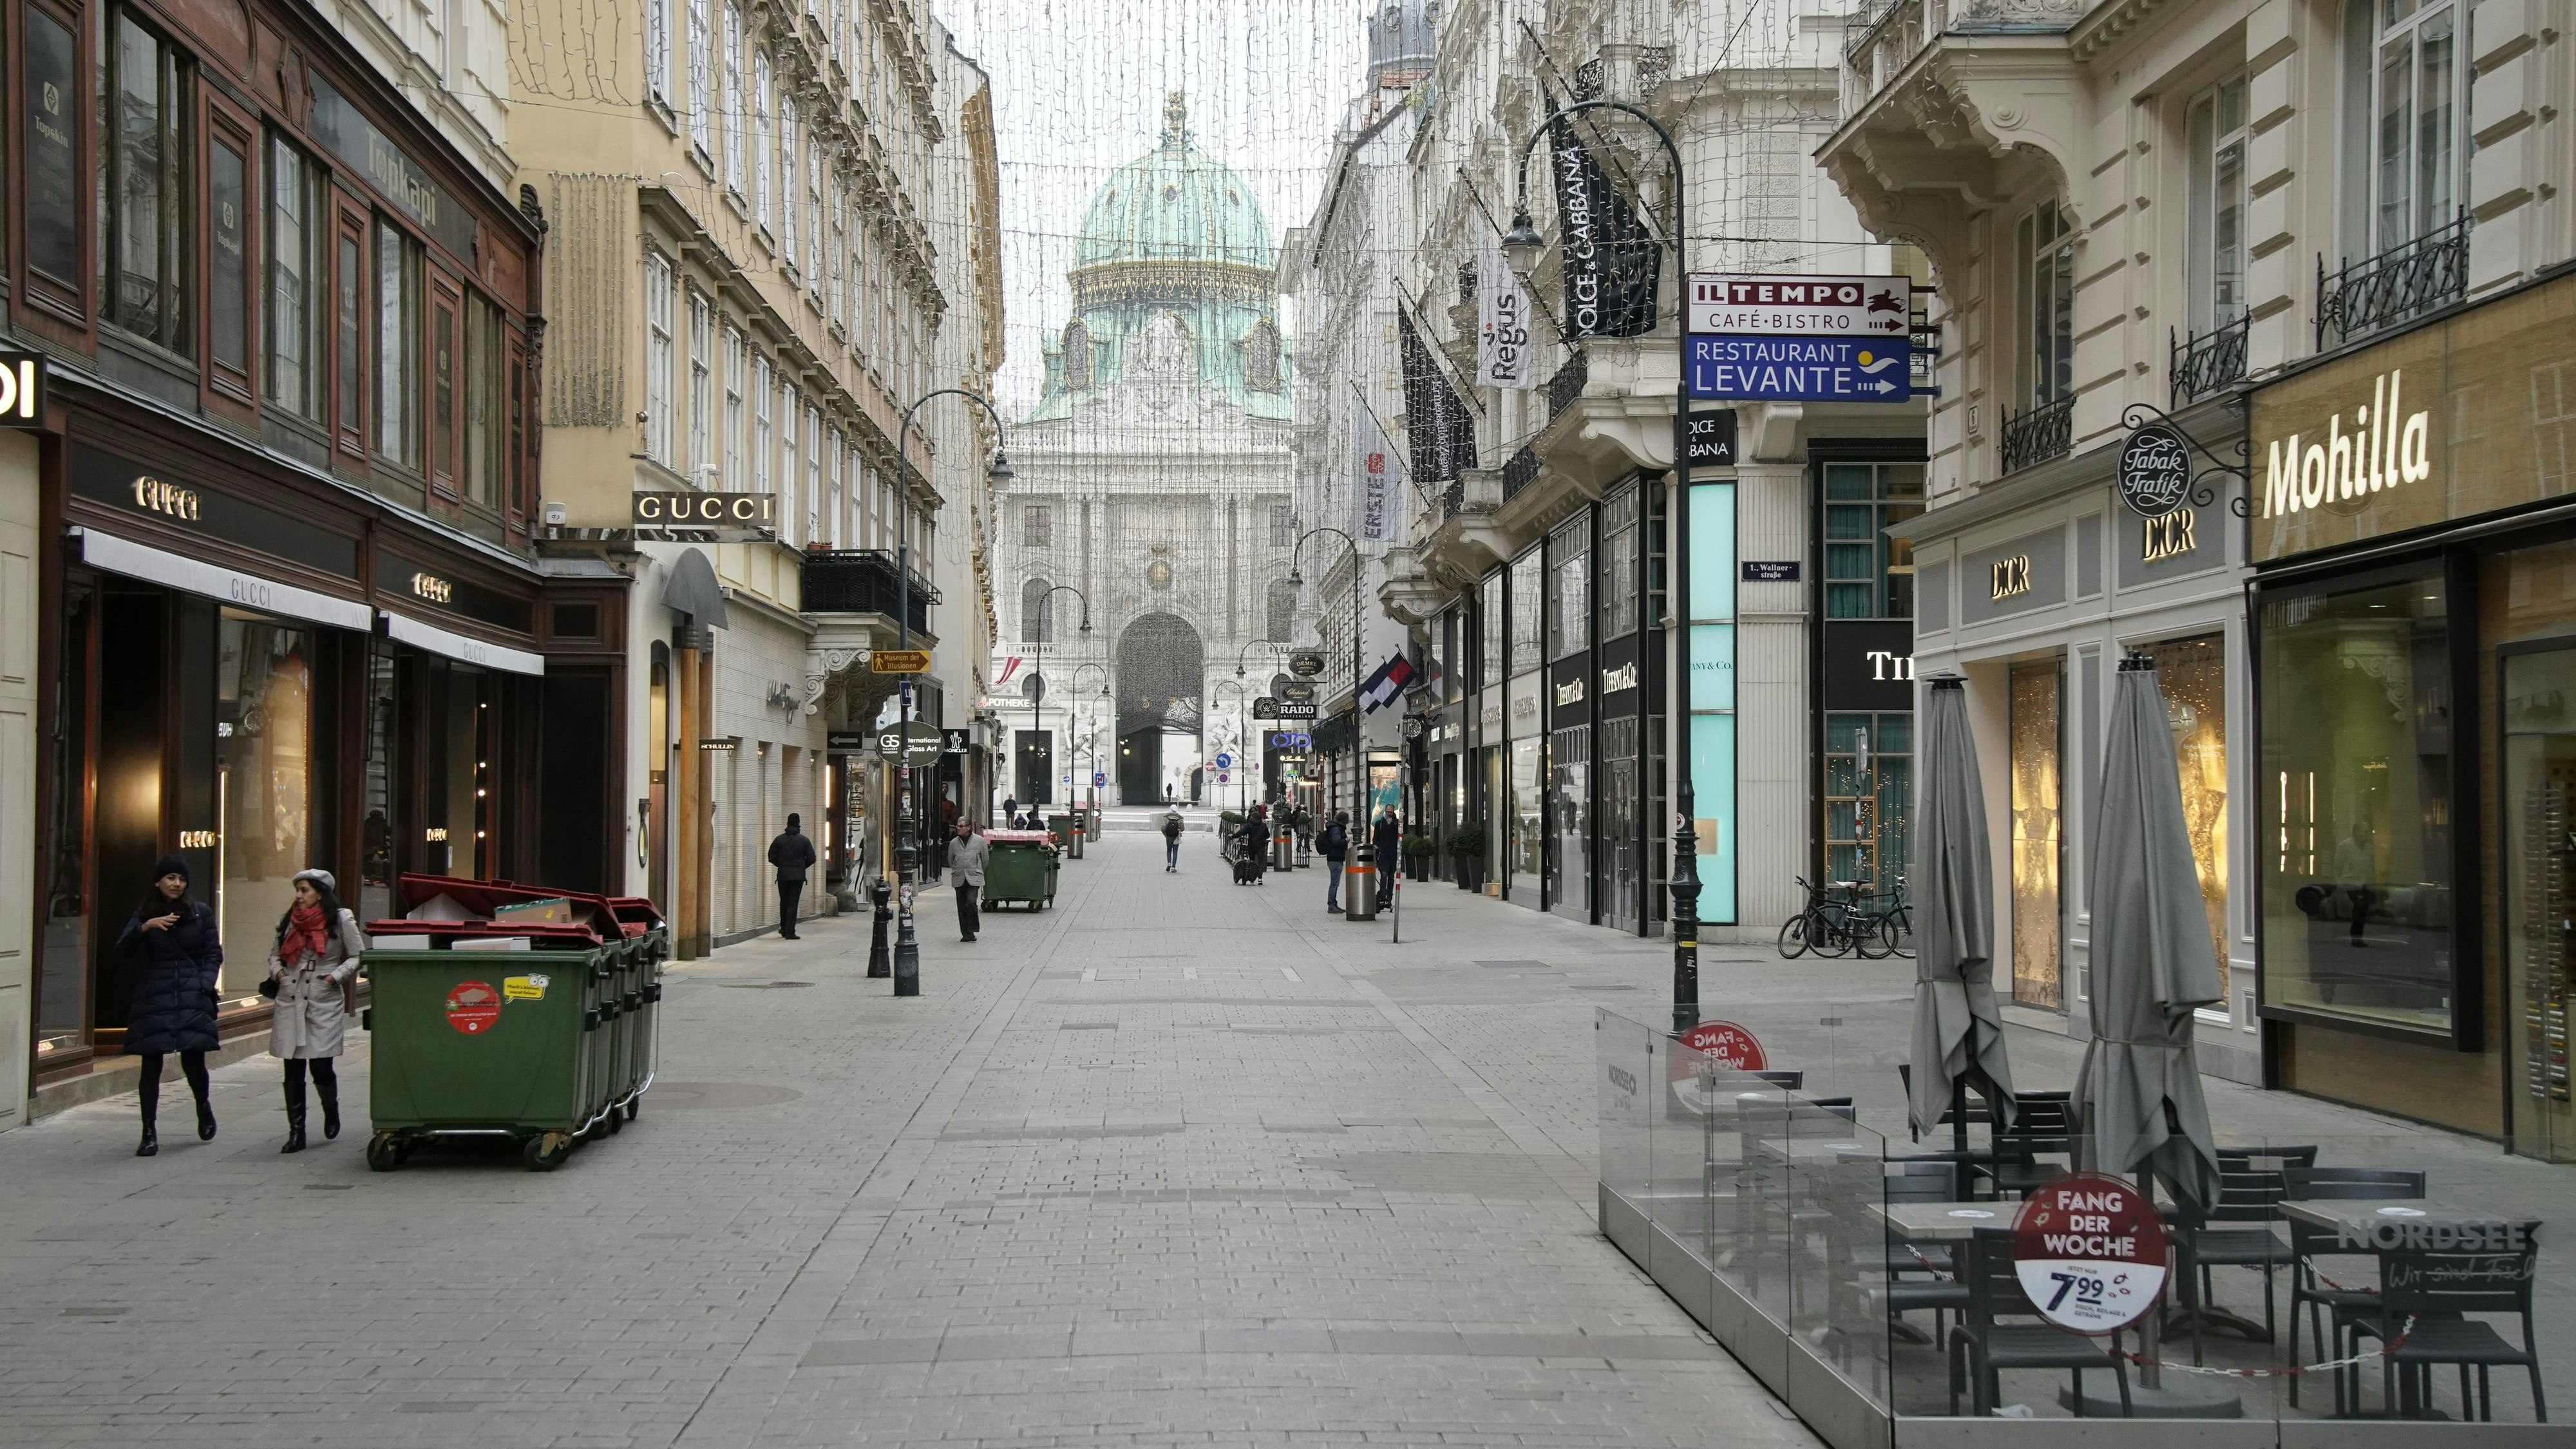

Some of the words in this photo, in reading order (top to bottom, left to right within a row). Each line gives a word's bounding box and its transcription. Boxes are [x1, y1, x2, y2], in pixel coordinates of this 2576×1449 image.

[35, 115, 68, 147] Topskin
[366, 126, 435, 229] Topkapi
[1698, 285, 1724, 301] IL
[1732, 285, 1859, 303] TEMPO
[1492, 294, 1528, 381] Regus
[1696, 342, 1852, 363] RESTAURANT
[1696, 365, 1852, 393] LEVANTE
[2263, 368, 2430, 519] Mohilla
[2125, 448, 2185, 471] Tabak
[2125, 471, 2184, 495] Trafik
[639, 497, 770, 520] GUCCI
[1364, 477, 1385, 540] ERSTE
[232, 578, 270, 607] GUCCI
[464, 643, 486, 663] GUCCI
[977, 696, 1030, 707] APOTHEKE
[880, 734, 900, 747] GS
[2058, 1191, 2123, 1213] FANG
[2070, 1215, 2110, 1233] DER
[2338, 1219, 2526, 1249] NORDSEE
[2043, 1233, 2136, 1256] WOCHE
[2389, 1262, 2426, 1288] Wir
